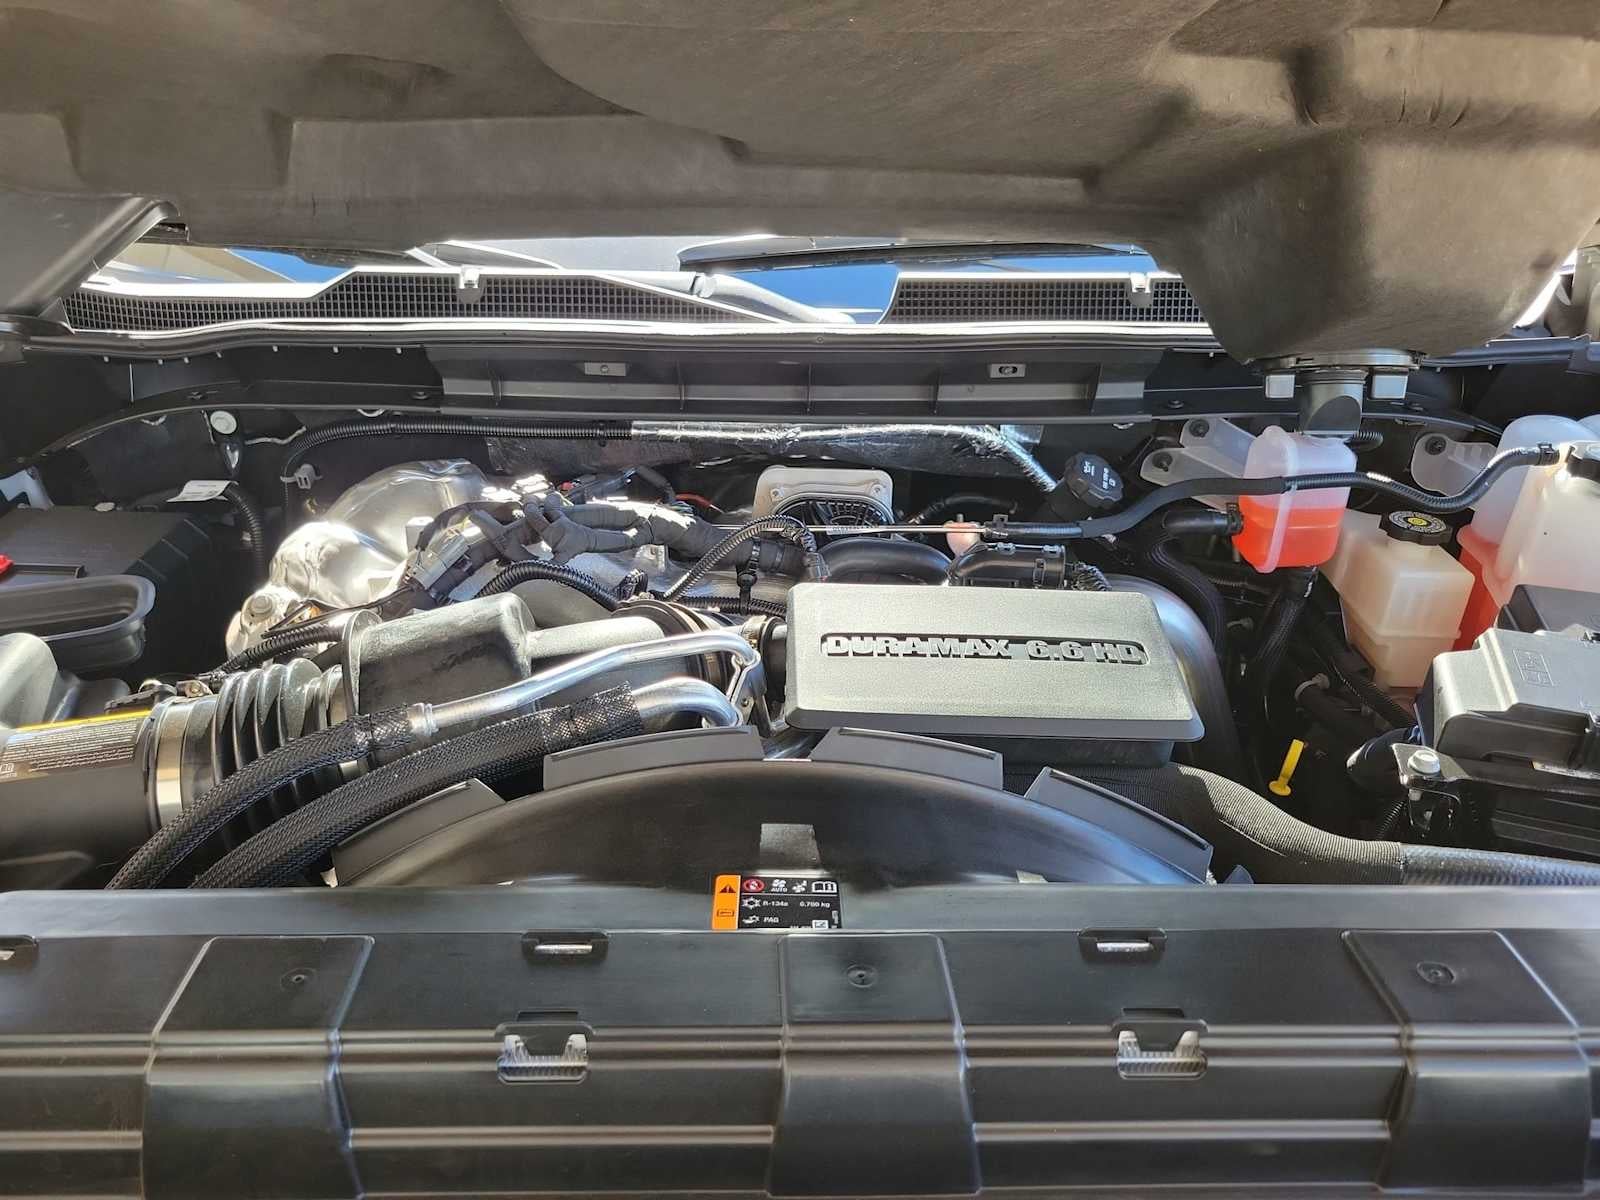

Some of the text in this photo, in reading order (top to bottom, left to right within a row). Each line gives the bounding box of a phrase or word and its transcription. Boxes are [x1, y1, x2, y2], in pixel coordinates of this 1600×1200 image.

[826, 636, 1144, 665] DURAMAX 6.6 HD
